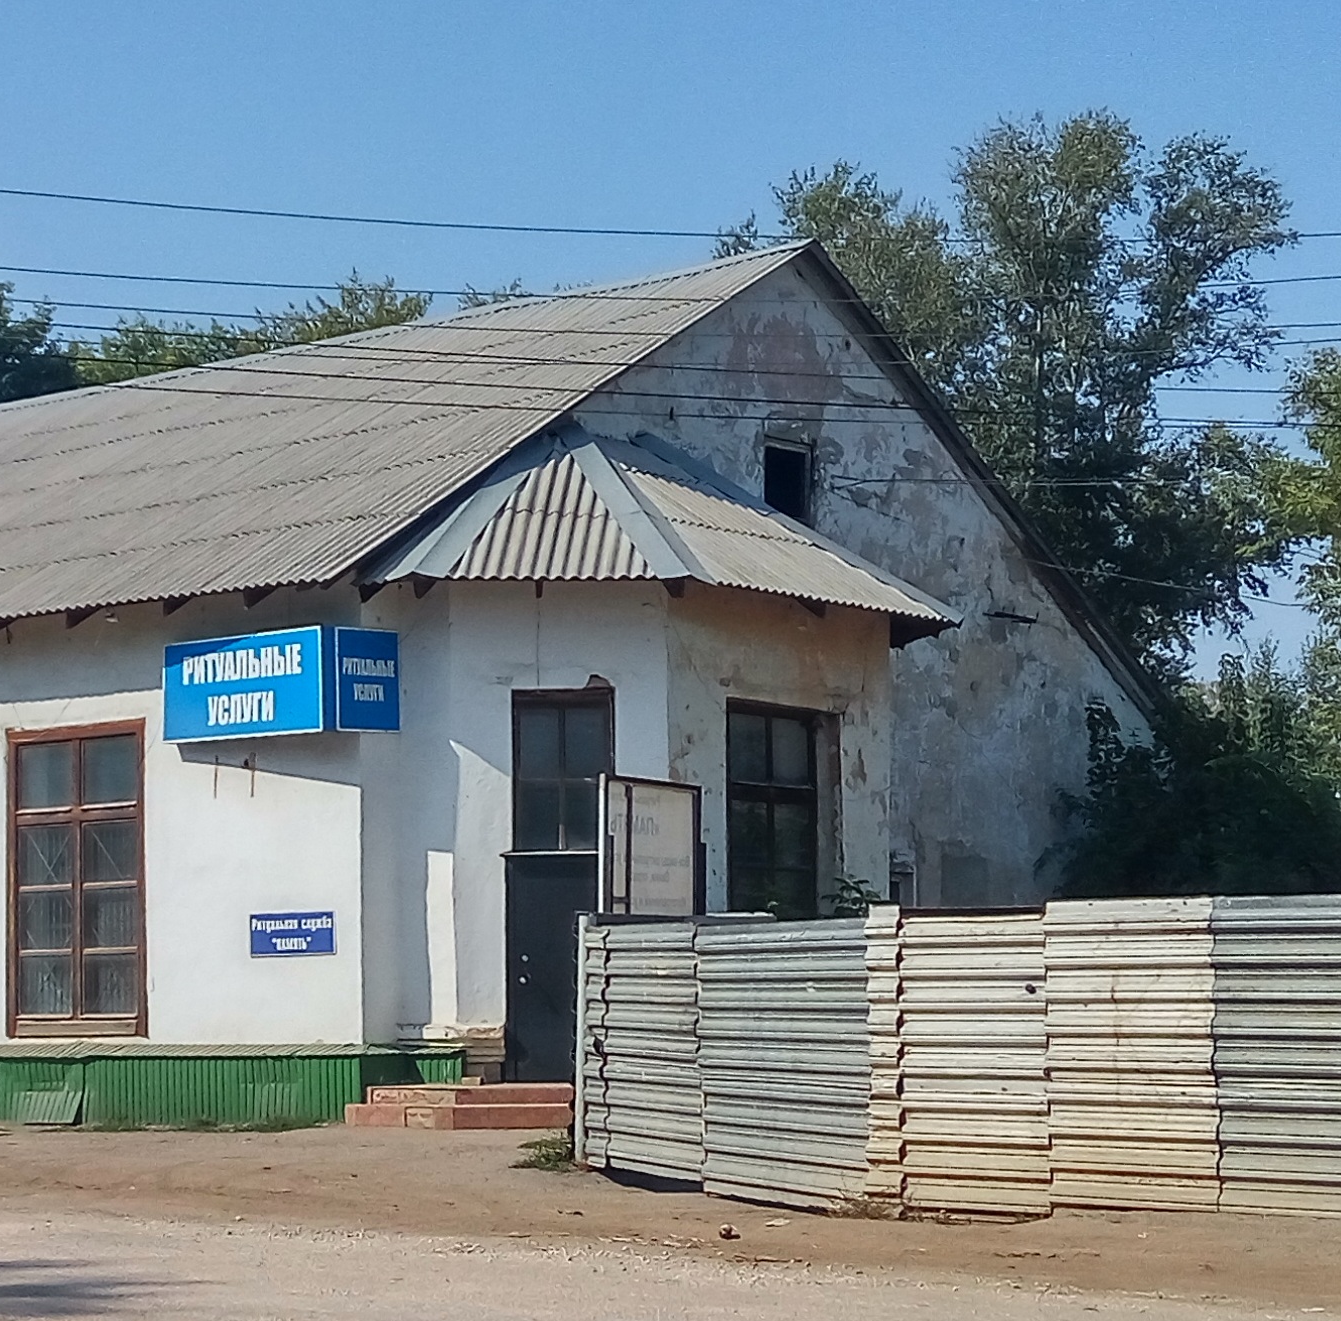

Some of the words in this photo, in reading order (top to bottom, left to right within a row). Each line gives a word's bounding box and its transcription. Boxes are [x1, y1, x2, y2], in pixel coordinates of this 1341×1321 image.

[182, 643, 302, 685] РИТУАЛЬНЫЕ
[342, 656, 396, 678] РИТУАЛЬНЫЕ
[353, 683, 385, 702] УСЛУГИ
[207, 690, 275, 727] УСЛУГИ
